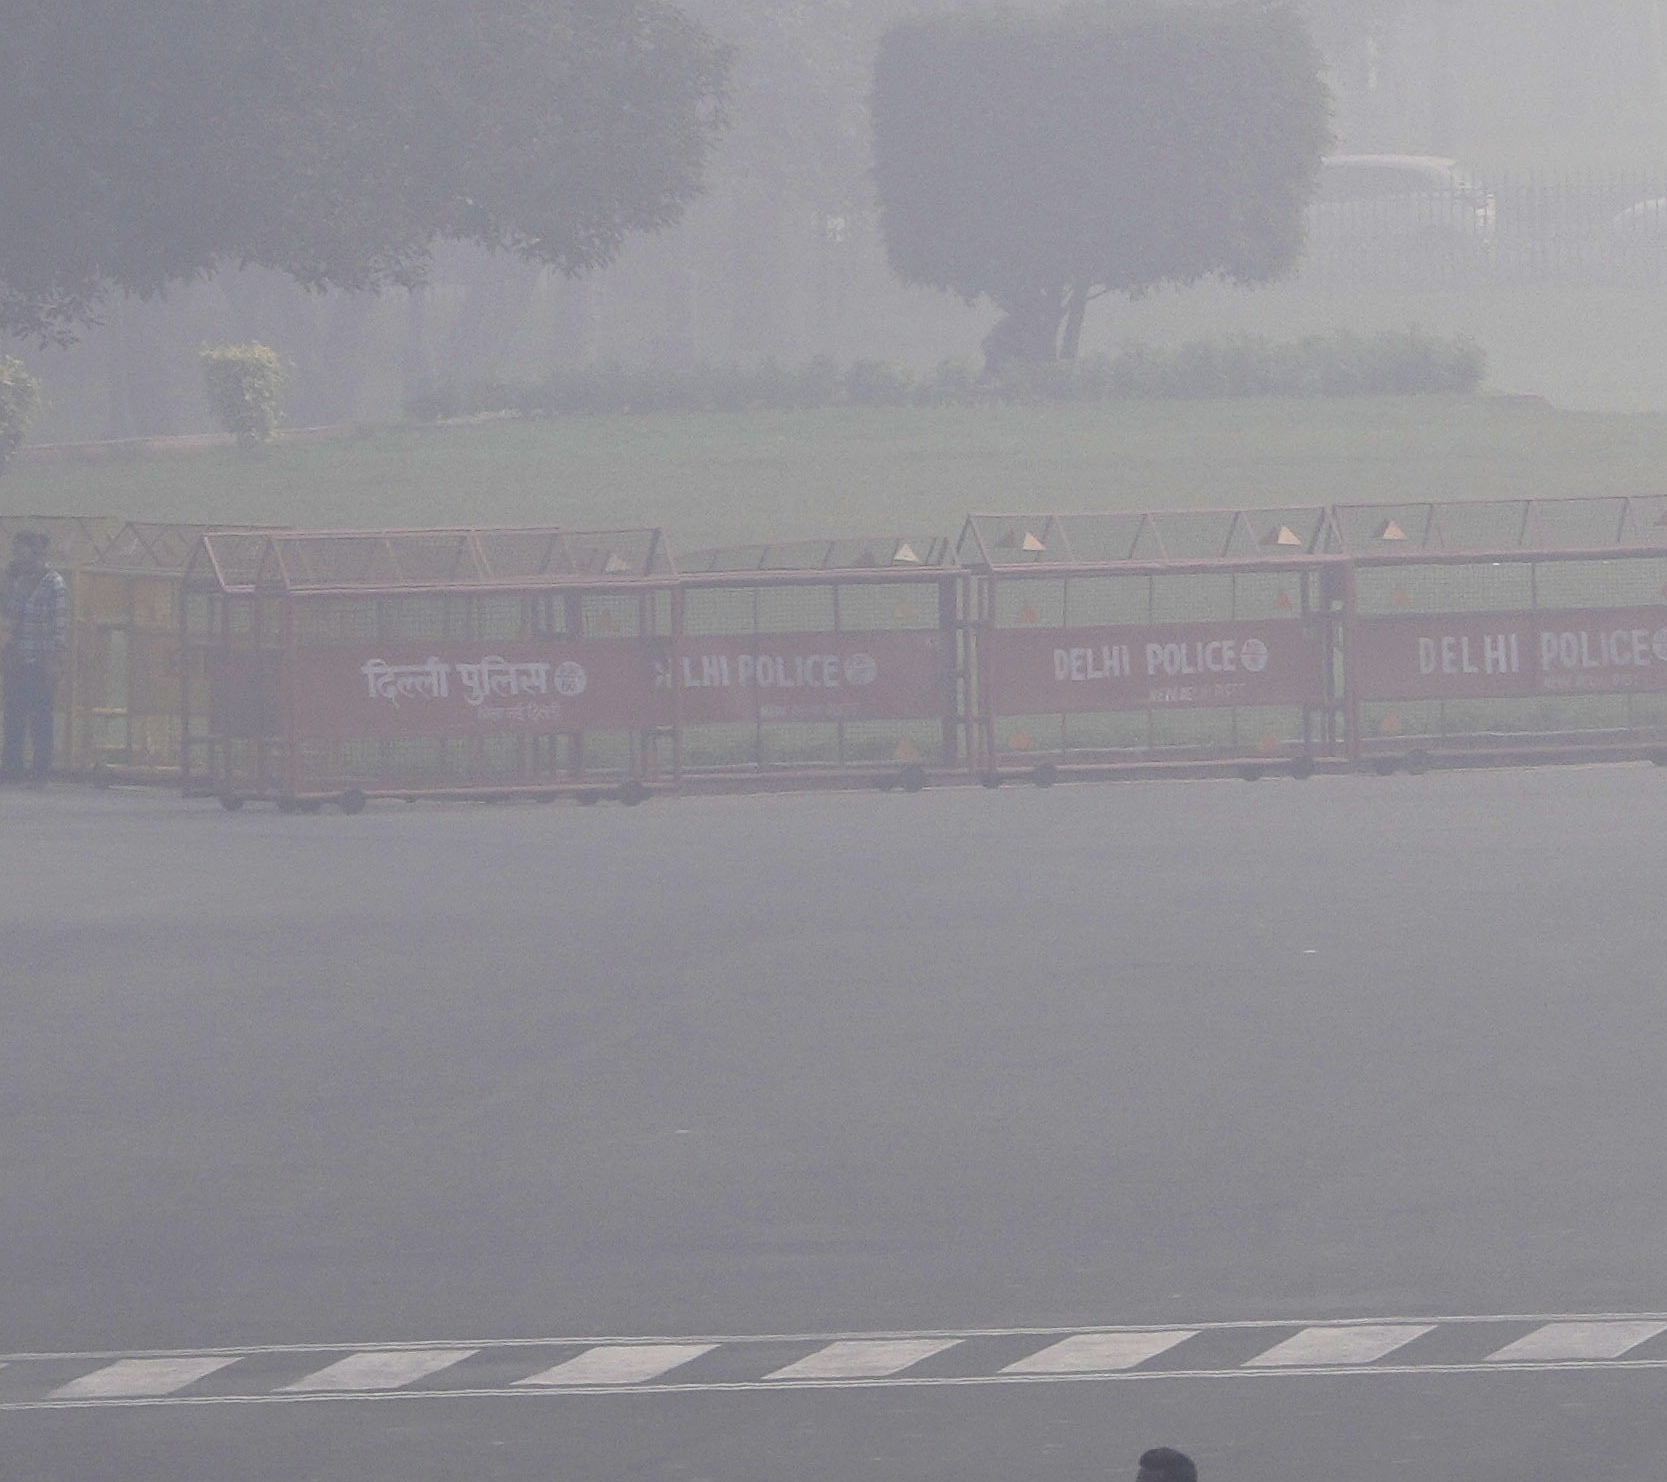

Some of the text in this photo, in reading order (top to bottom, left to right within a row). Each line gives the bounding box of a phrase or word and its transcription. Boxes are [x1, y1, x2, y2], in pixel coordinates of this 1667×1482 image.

[738, 654, 841, 688] POLICE
[1053, 645, 1131, 681] DELHI
[1146, 640, 1237, 676] POLICE
[1418, 633, 1521, 675] DELHI
[1540, 629, 1651, 672] POLICE
[362, 656, 450, 709] दिल्ली
[455, 655, 551, 706] पुलिस
